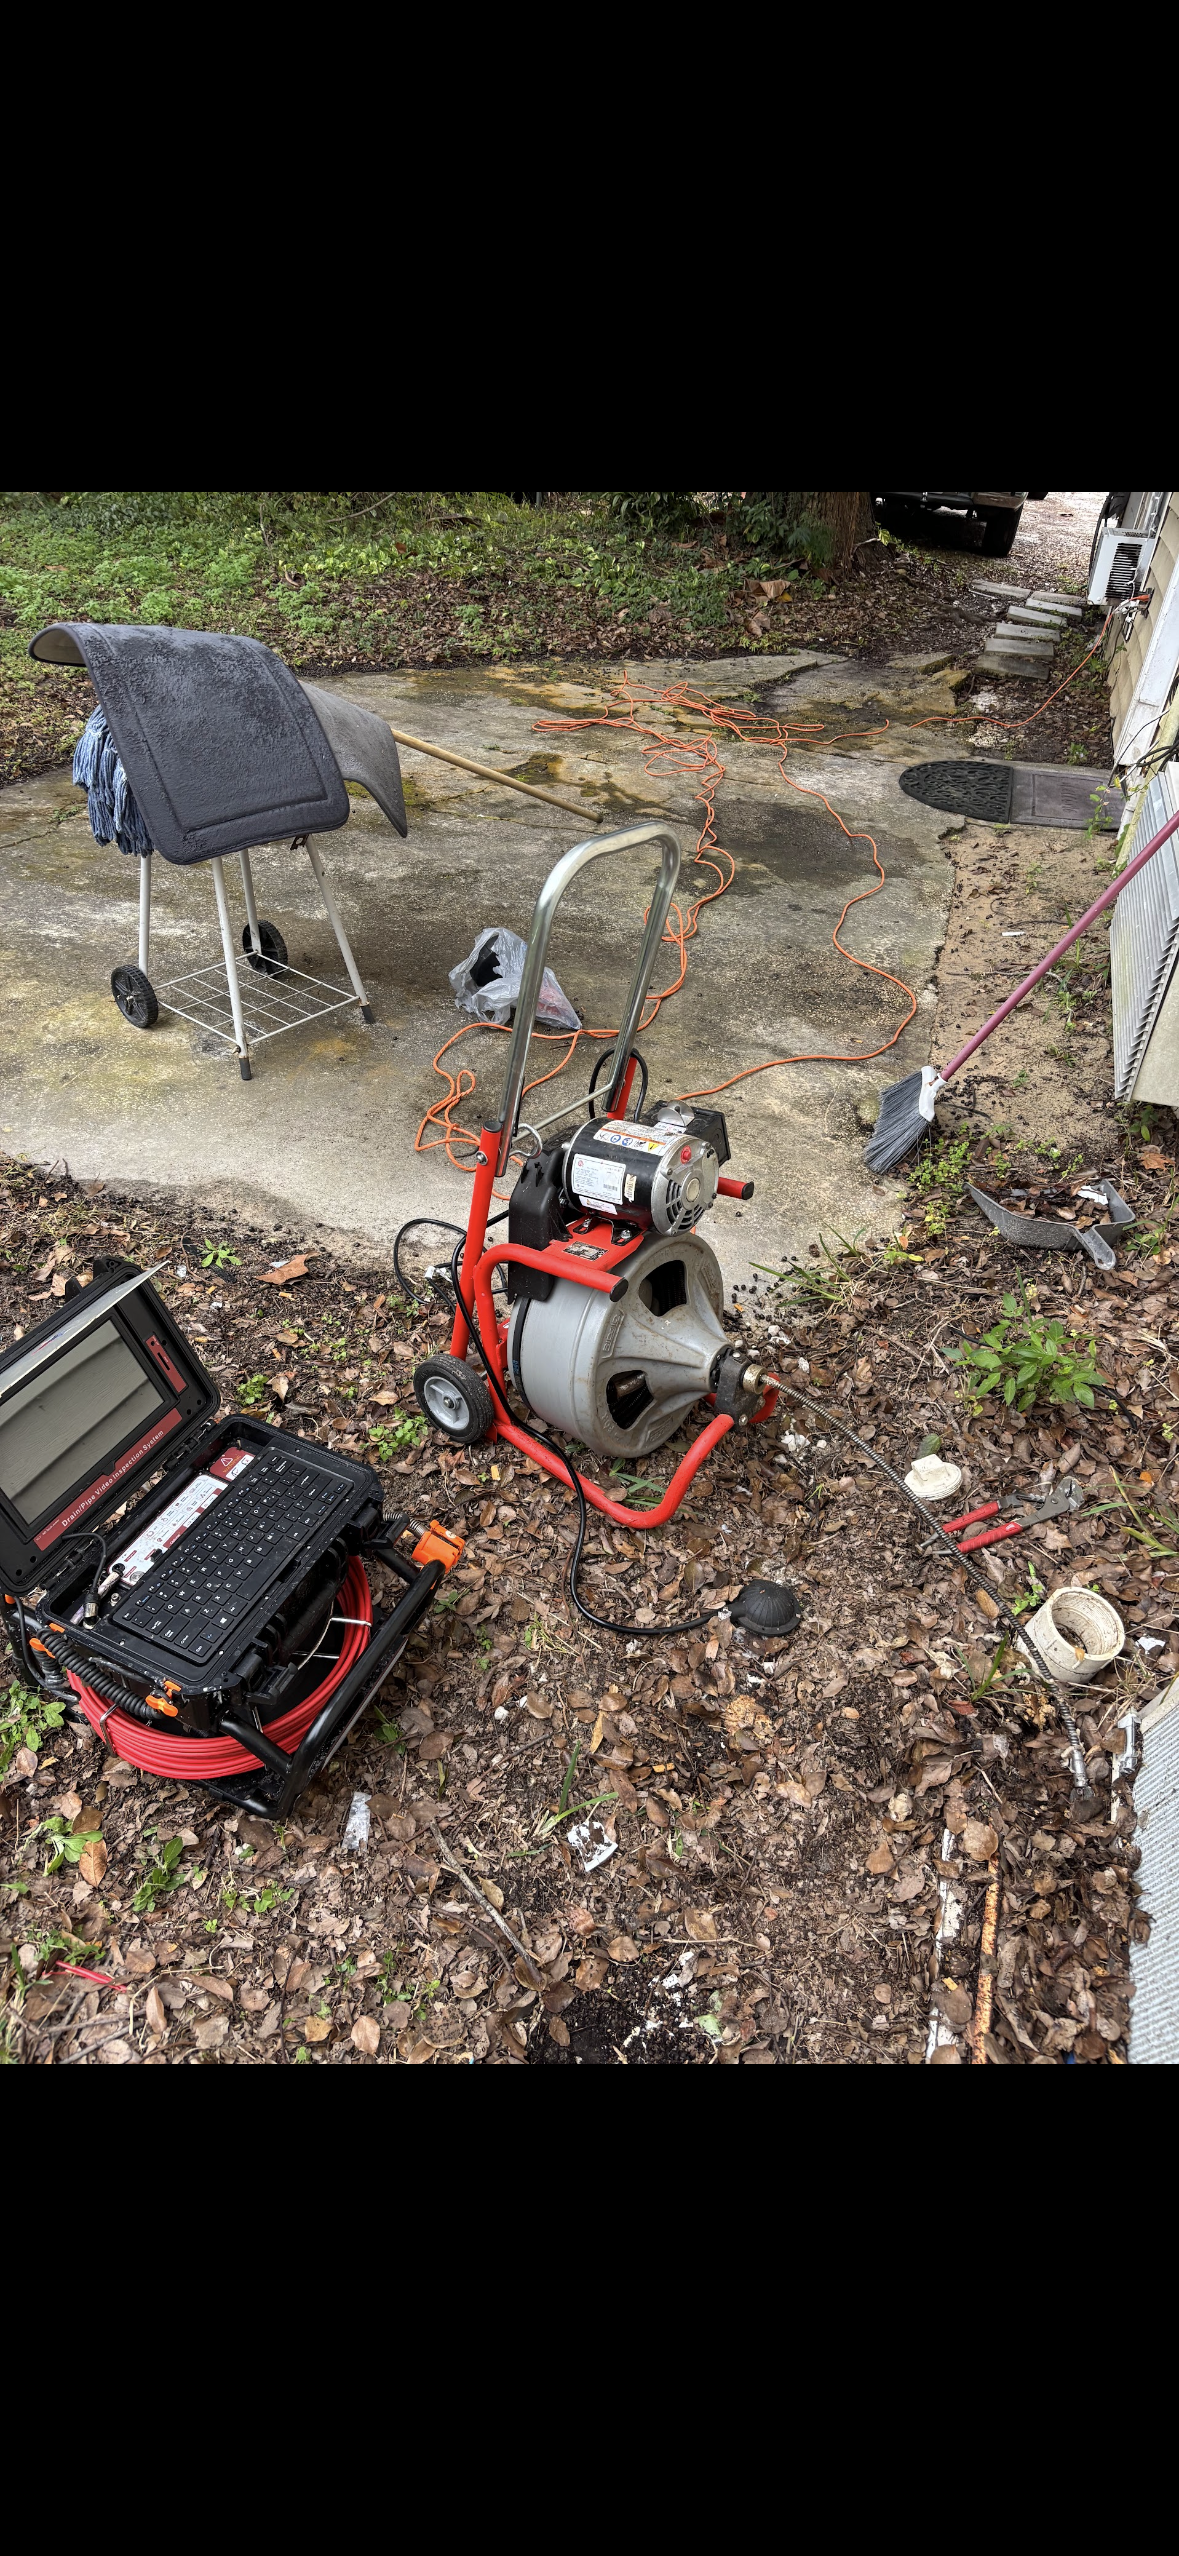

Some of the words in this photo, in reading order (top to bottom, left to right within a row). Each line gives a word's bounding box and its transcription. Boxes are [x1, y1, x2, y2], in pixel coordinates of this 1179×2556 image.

[61, 1494, 96, 1527] Drain/Pipe
[95, 1478, 113, 1496] Video
[112, 1449, 144, 1480] Inspection
[142, 1430, 164, 1452] System
